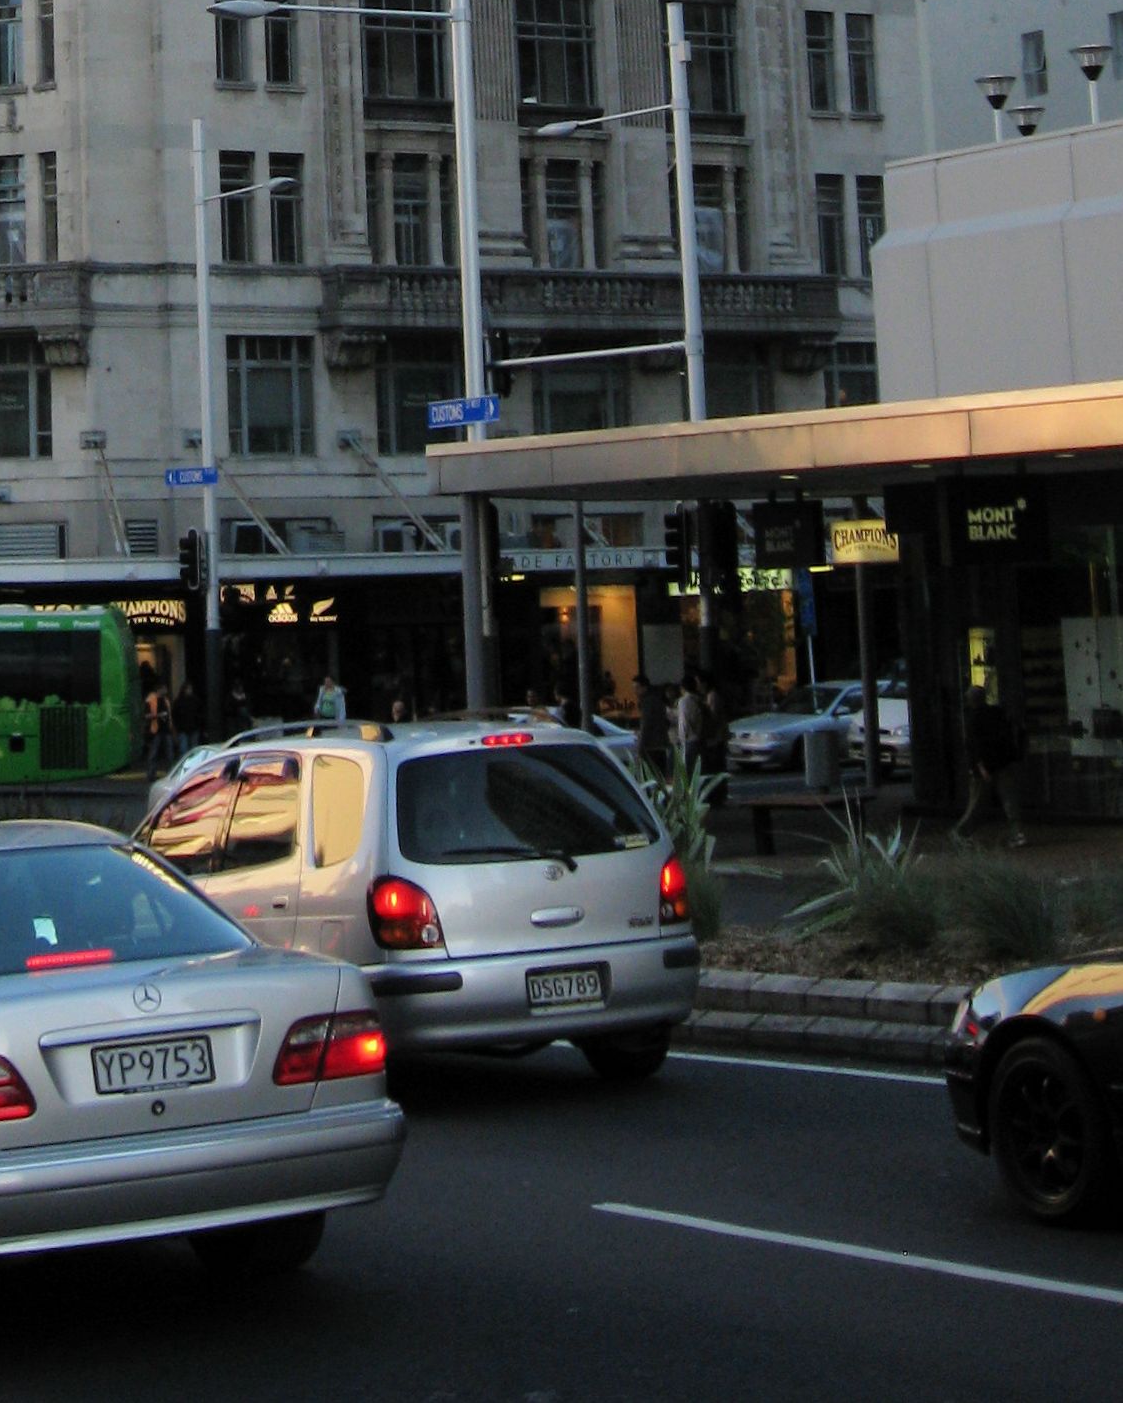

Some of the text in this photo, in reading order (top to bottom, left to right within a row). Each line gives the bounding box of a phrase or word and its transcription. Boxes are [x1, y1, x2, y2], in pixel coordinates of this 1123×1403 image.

[431, 403, 464, 423] CUSTOMS
[179, 470, 204, 483] CUSTOMS
[967, 507, 1015, 524] MONT
[834, 528, 898, 552] CHAMPIONS
[968, 524, 1017, 541] BLANC
[554, 552, 635, 569] FATORY
[529, 973, 600, 1001] DSG789
[98, 1041, 209, 1086] YP9753
